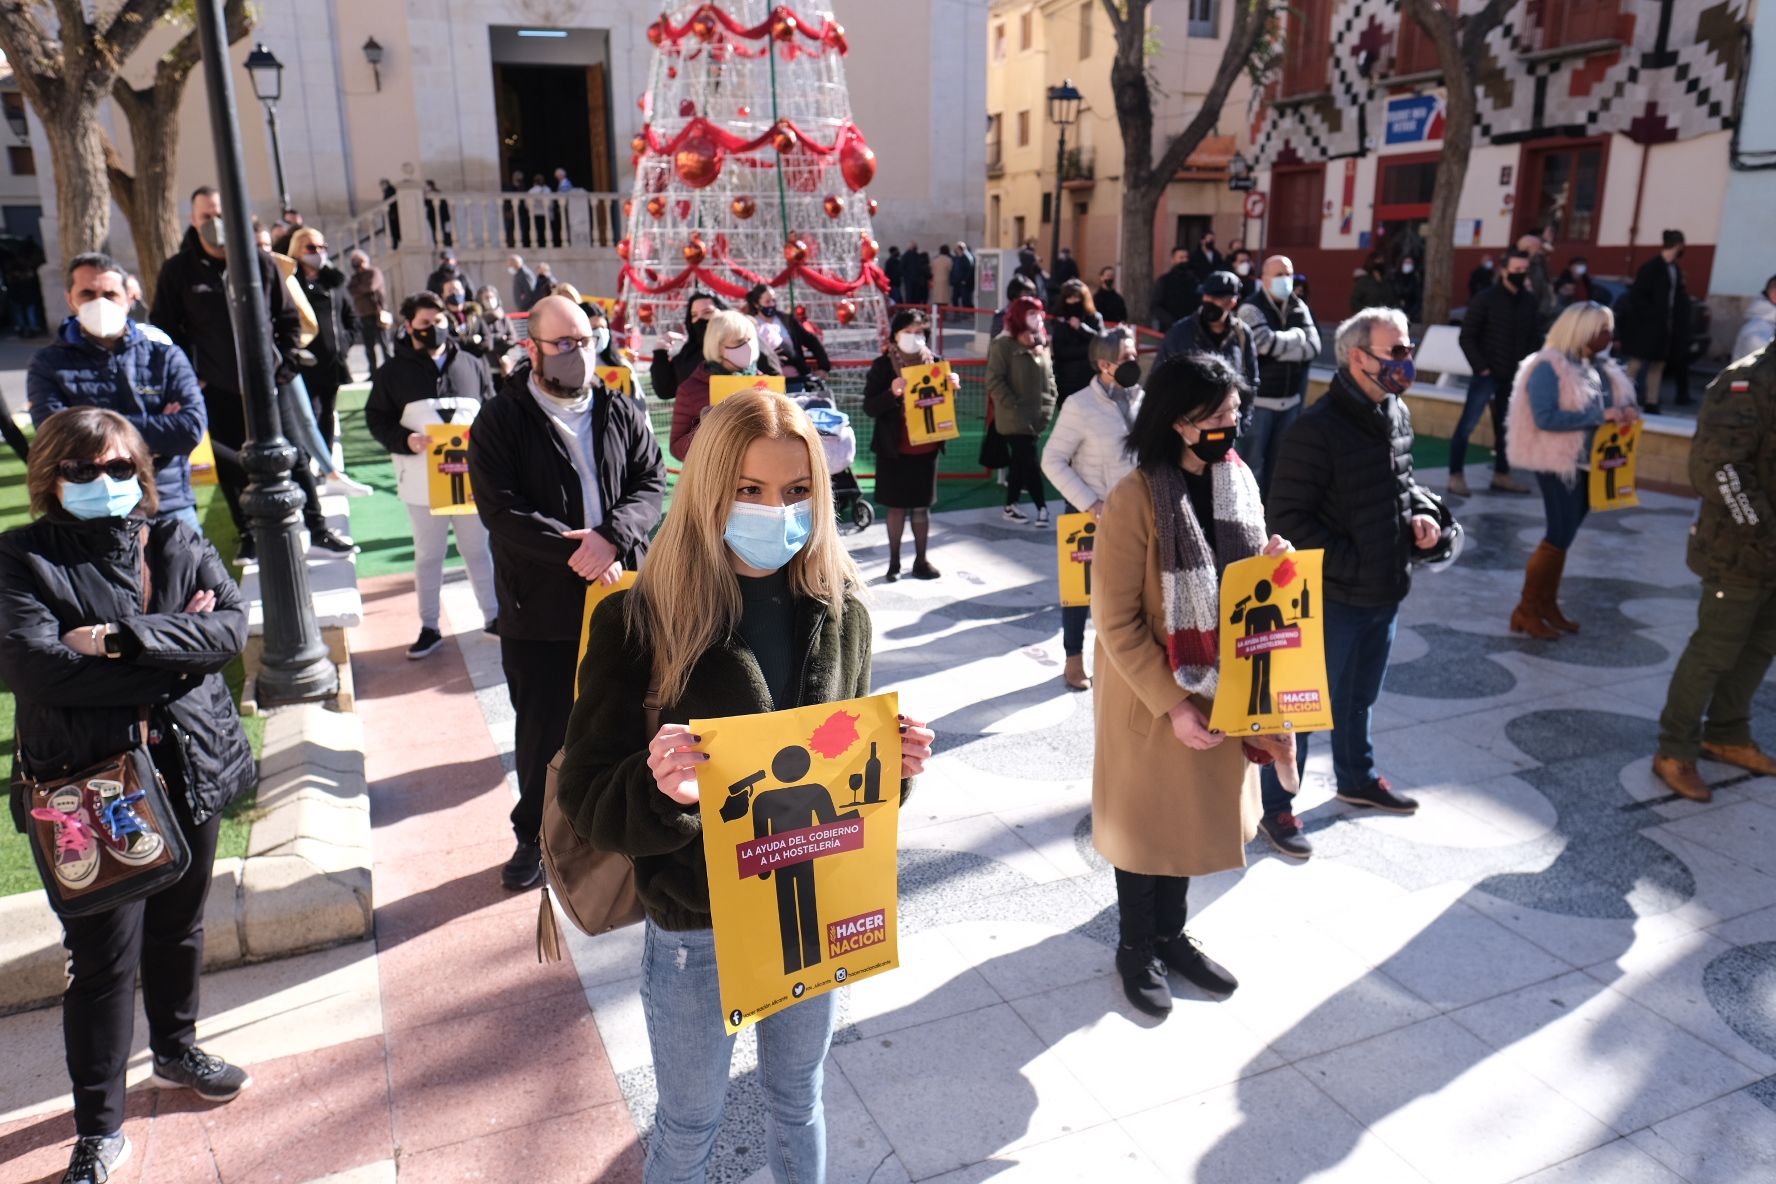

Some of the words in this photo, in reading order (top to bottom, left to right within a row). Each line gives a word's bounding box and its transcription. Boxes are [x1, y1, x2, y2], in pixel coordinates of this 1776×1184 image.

[1283, 692, 1319, 703] HACER
[741, 849, 753, 859] LA
[756, 839, 786, 856] AYUDA
[788, 836, 807, 846] DEL
[809, 825, 859, 841] GOBIERNO
[760, 857, 768, 866] A
[769, 853, 781, 863] LA
[783, 838, 841, 859] HOSTELERÍA
[836, 914, 883, 938] HACER
[830, 929, 884, 956] NACIÓN
